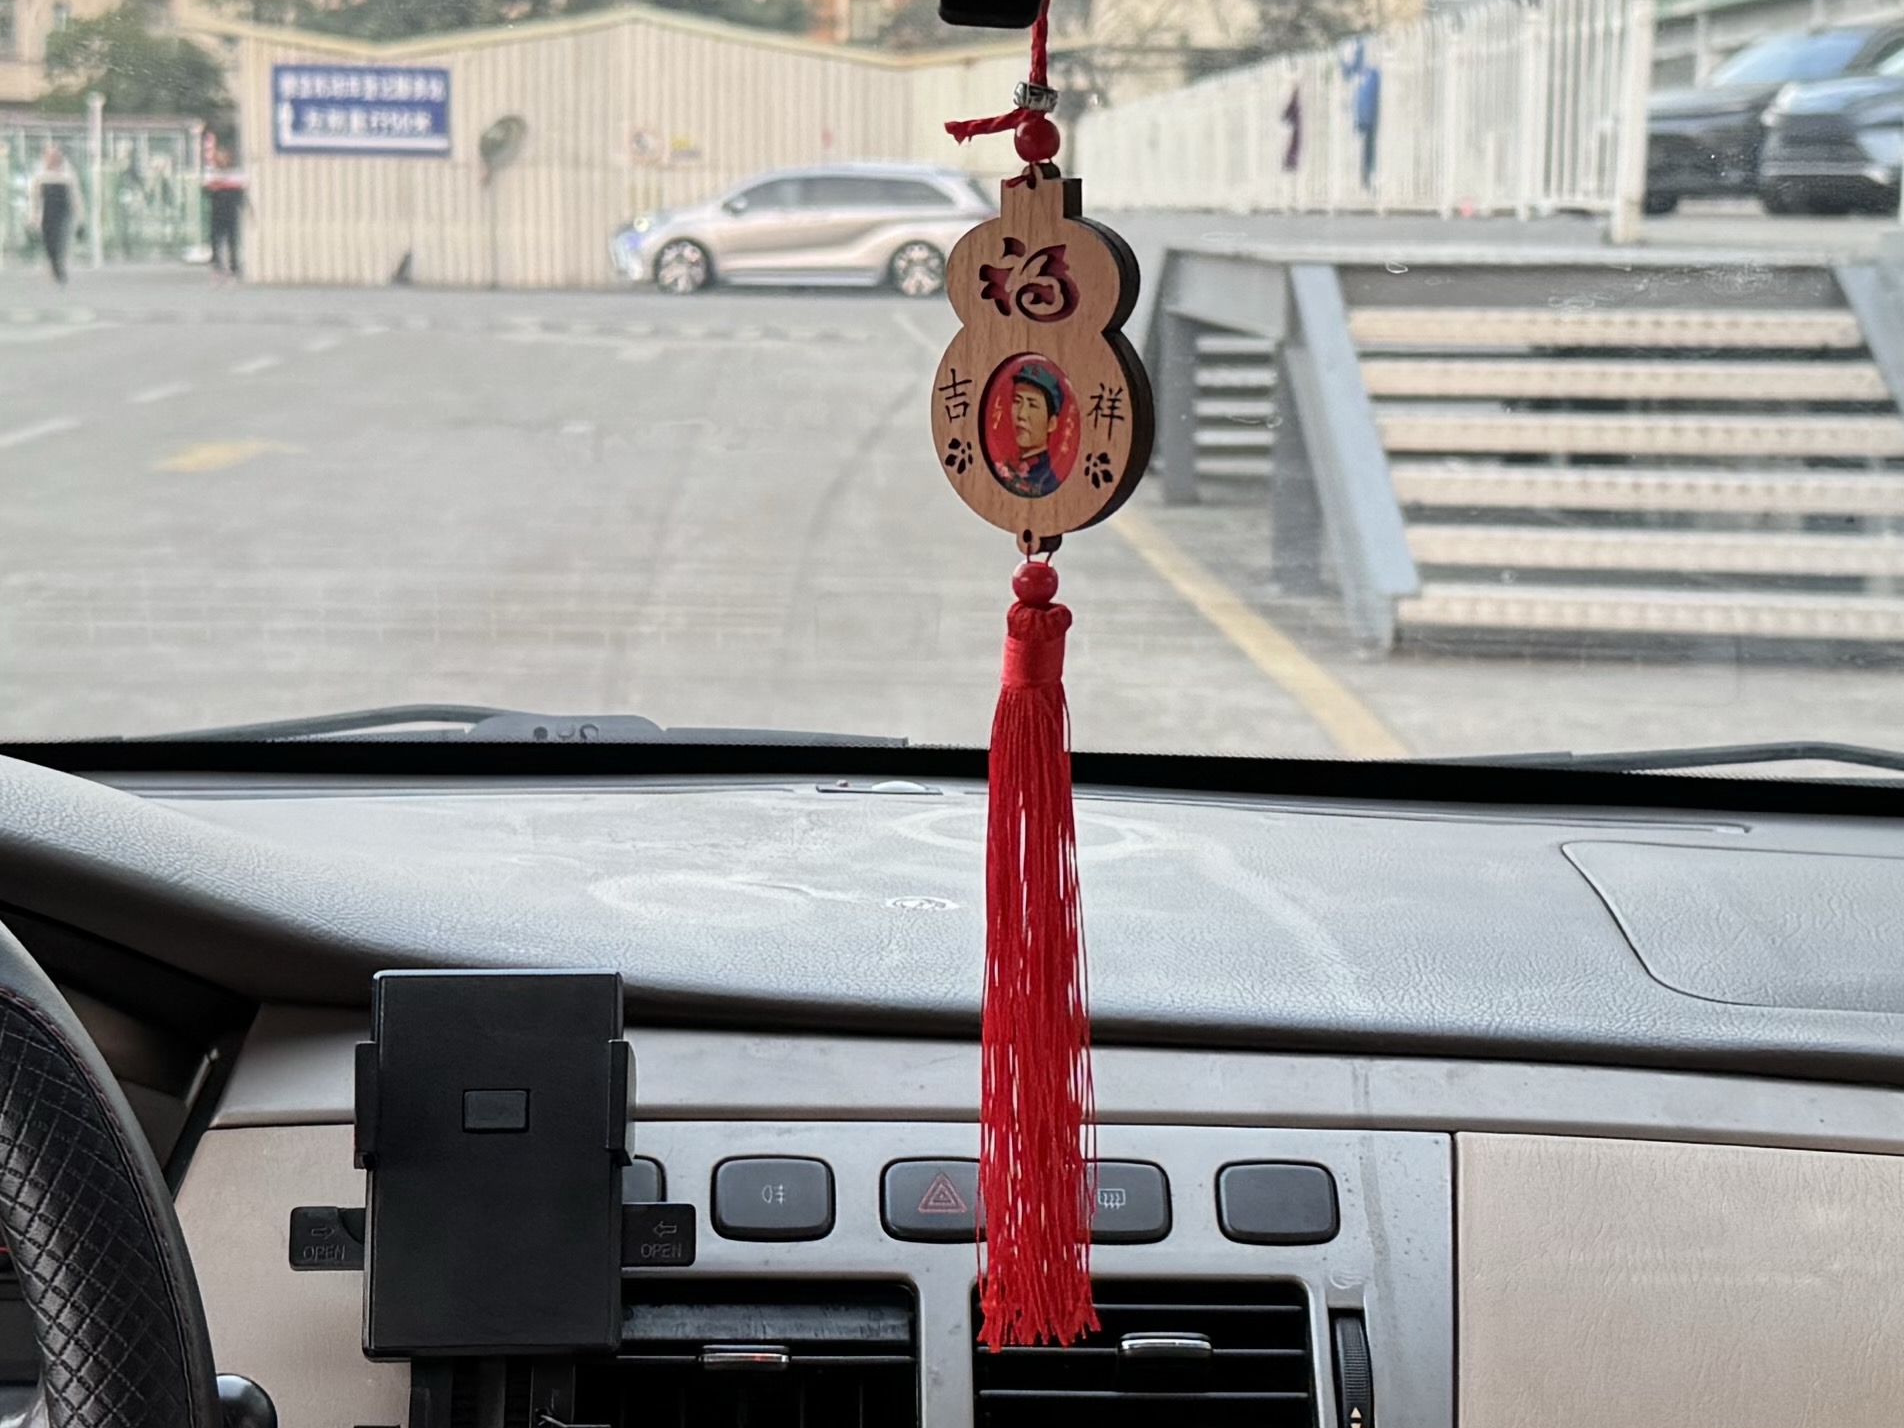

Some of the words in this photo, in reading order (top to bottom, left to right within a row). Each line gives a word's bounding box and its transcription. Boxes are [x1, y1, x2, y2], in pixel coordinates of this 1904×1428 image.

[978, 236, 1081, 323] 福
[938, 368, 973, 425] 吉
[1087, 382, 1125, 442] 祥
[303, 1244, 346, 1263] OPEN
[641, 1243, 682, 1259] OPEN
